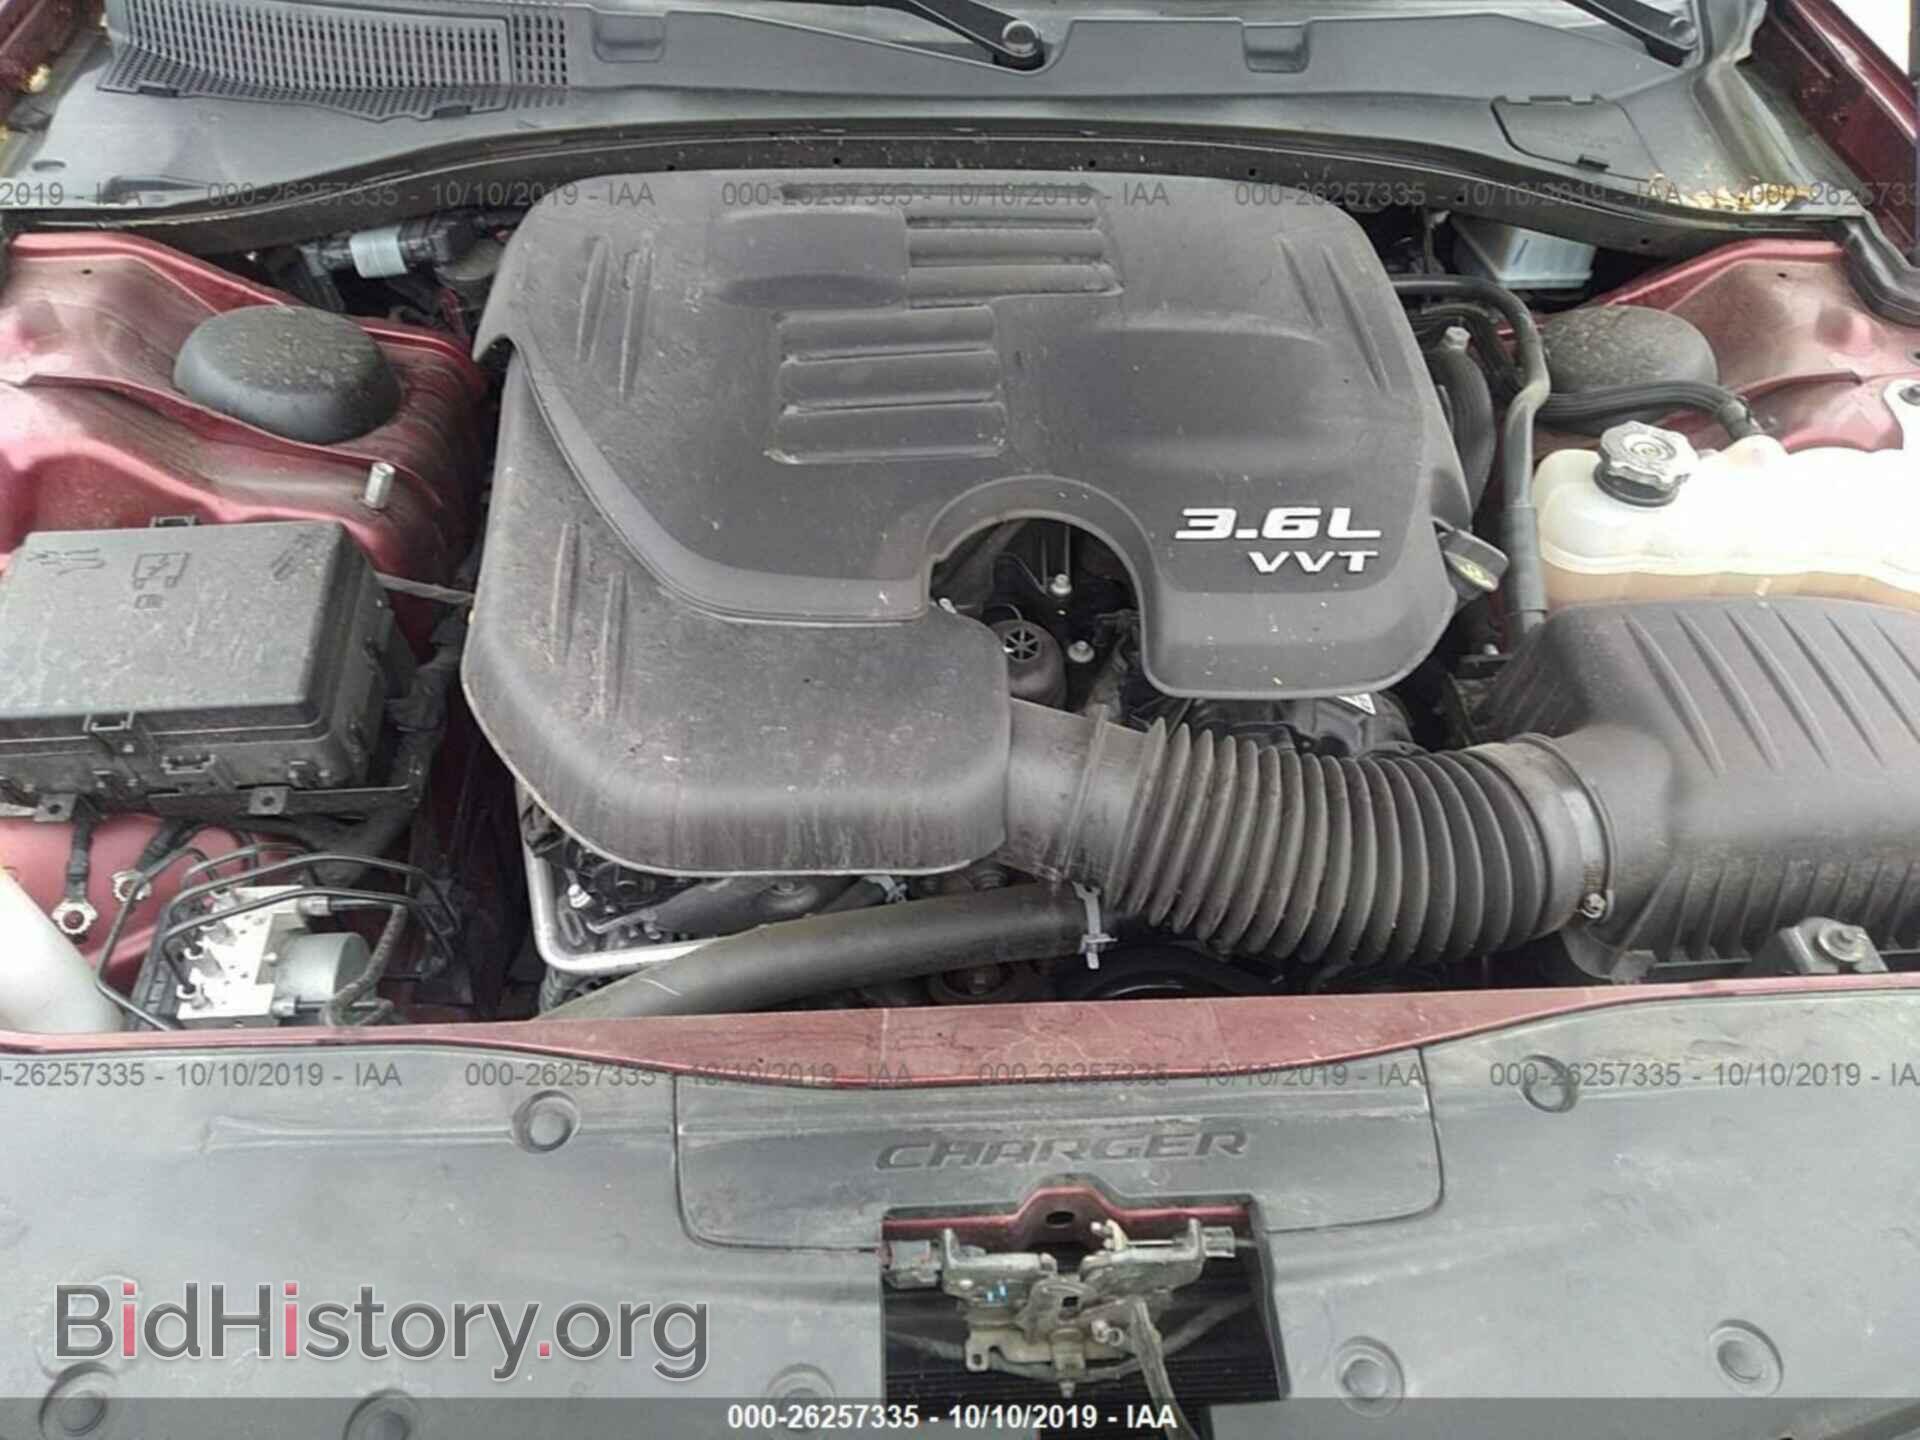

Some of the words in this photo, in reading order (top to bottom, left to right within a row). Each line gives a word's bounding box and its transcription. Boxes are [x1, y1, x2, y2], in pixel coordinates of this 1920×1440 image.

[1175, 507, 1382, 540] 3.6L
[1248, 550, 1379, 573] VVT
[875, 1130, 1250, 1172] CHARGER
